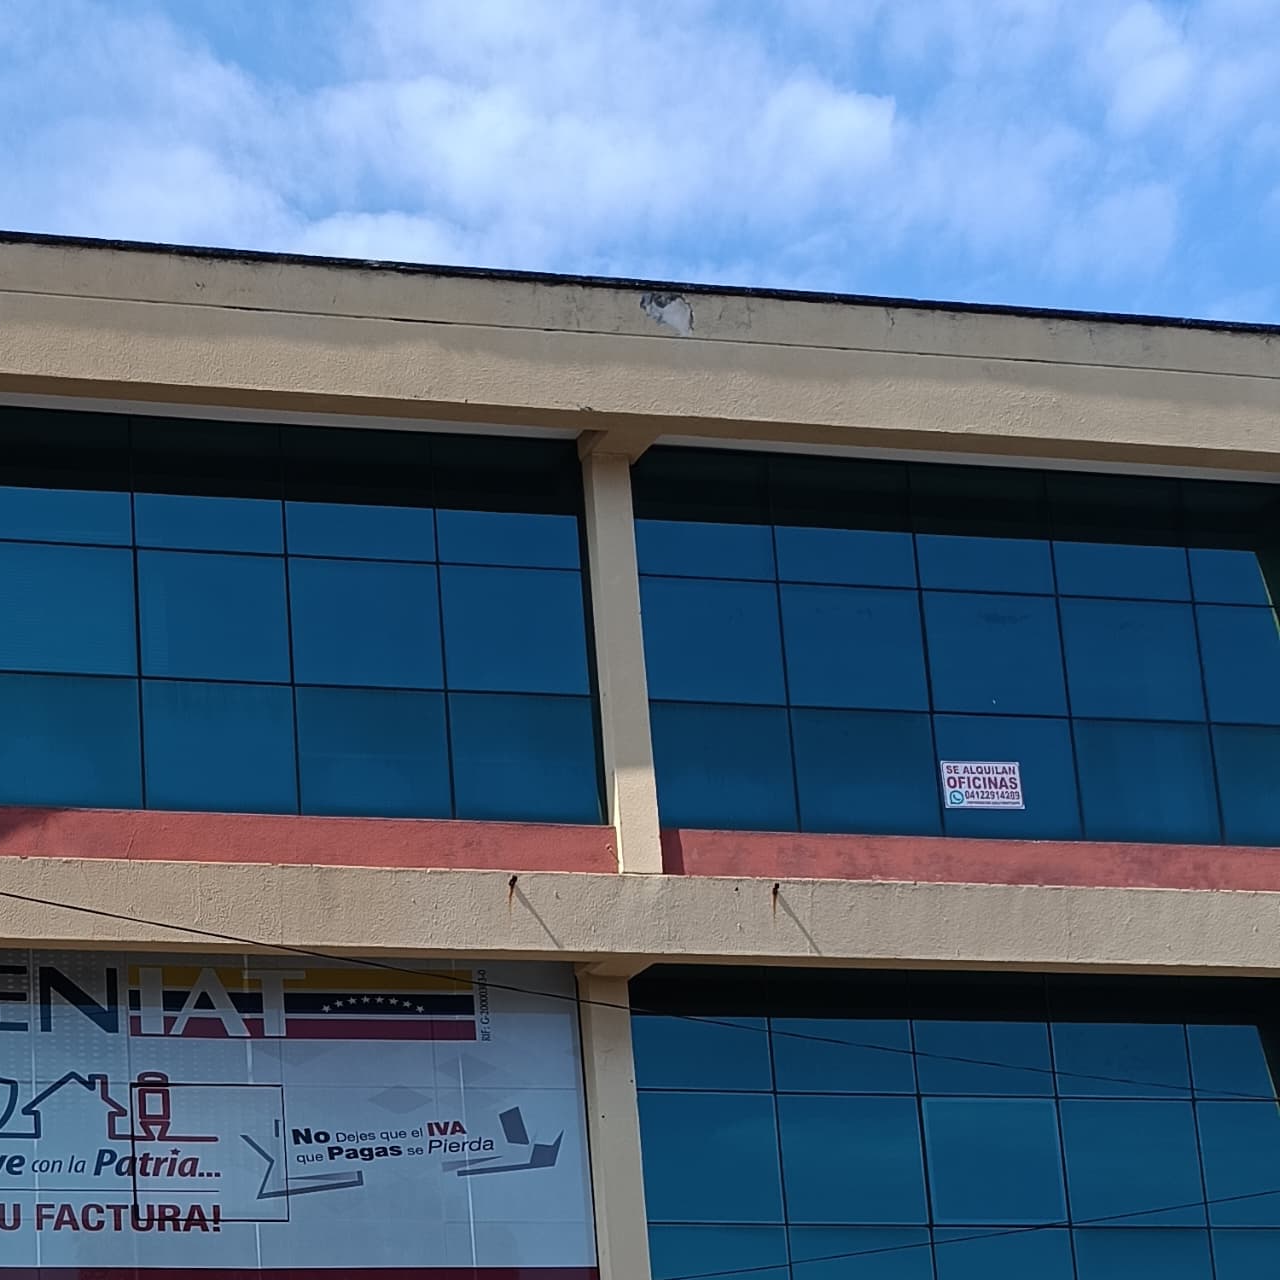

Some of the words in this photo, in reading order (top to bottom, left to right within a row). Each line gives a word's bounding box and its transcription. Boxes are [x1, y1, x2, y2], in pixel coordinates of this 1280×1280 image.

[946, 765, 959, 774] SE
[963, 766, 1015, 775] ALQUILAN
[947, 776, 1018, 790] OFICINAS
[292, 1128, 331, 1145] No
[336, 1129, 377, 1145] Dejes
[380, 1129, 408, 1143] que
[411, 1126, 424, 1139] el
[427, 1120, 467, 1136] IVA
[296, 1151, 324, 1165] que
[328, 1143, 403, 1162] Pagas
[407, 1145, 425, 1156] se
[428, 1136, 495, 1154] Pierda
[31, 1157, 63, 1174] con
[66, 1154, 86, 1174] la
[36, 1203, 221, 1233] FACTURA!
